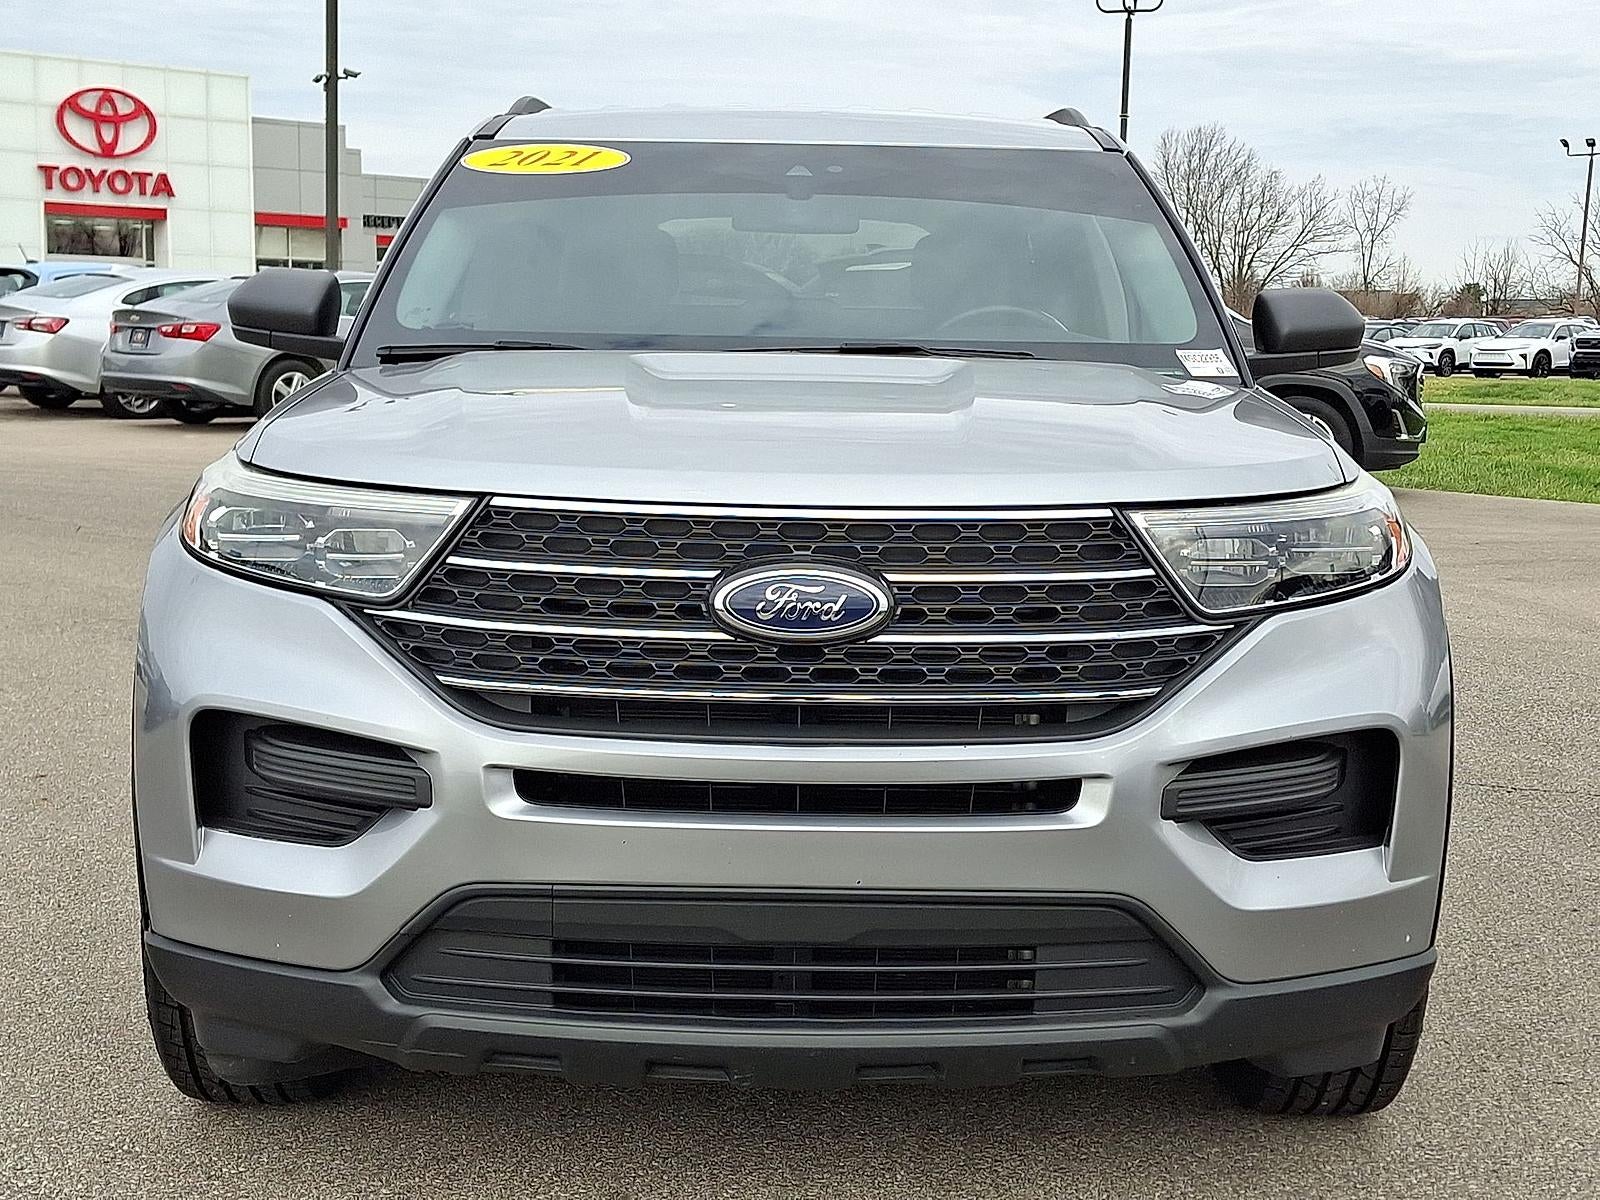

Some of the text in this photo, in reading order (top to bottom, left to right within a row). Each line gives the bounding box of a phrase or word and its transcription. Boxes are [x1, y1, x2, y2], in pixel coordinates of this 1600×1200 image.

[487, 150, 603, 167] 2021
[37, 165, 175, 197] TOYOTA
[755, 582, 848, 621] Ford
